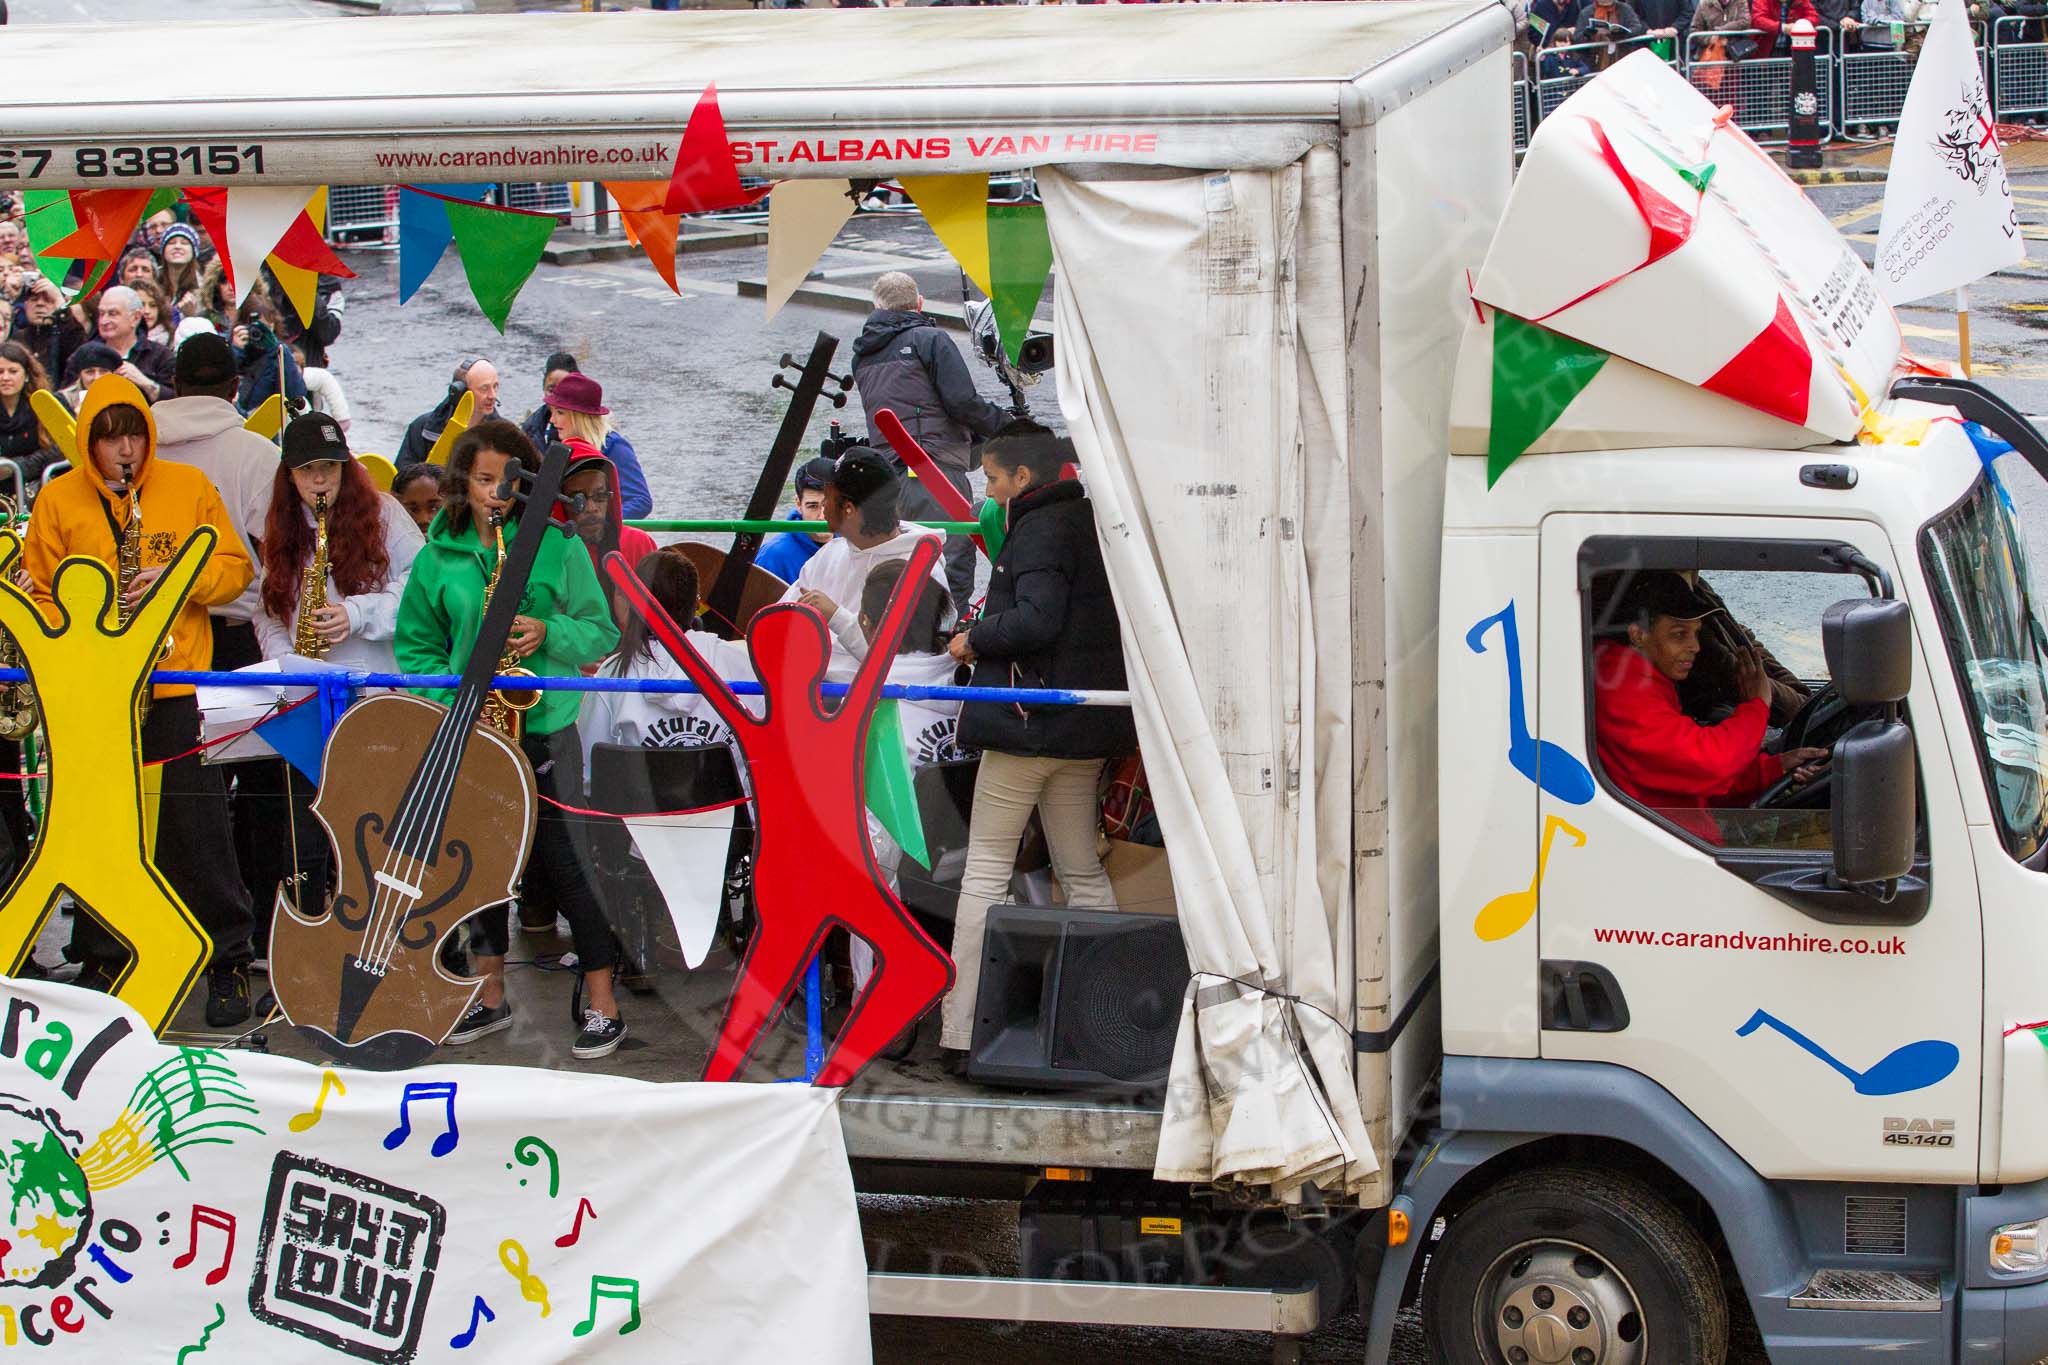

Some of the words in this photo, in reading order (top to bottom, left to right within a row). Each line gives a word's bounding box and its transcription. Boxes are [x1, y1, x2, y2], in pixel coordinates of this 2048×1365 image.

[76, 145, 265, 177] 838151
[376, 143, 669, 167] www.carandvanhire.co.uk
[729, 137, 951, 164] ST.ALBANS
[966, 135, 1050, 157] VAN
[1064, 133, 1158, 153] HIRE
[1884, 250, 1902, 272] City
[1903, 233, 1917, 252] of
[1913, 200, 1957, 240] London
[1890, 222, 1955, 283] Corporation
[1594, 927, 1906, 955] www.carandvanhire.co.uk
[1883, 1117, 1955, 1132] DAF
[1884, 1133, 1953, 1146] 45.140
[284, 1181, 385, 1259] SAY
[275, 1242, 413, 1339] LOUD
